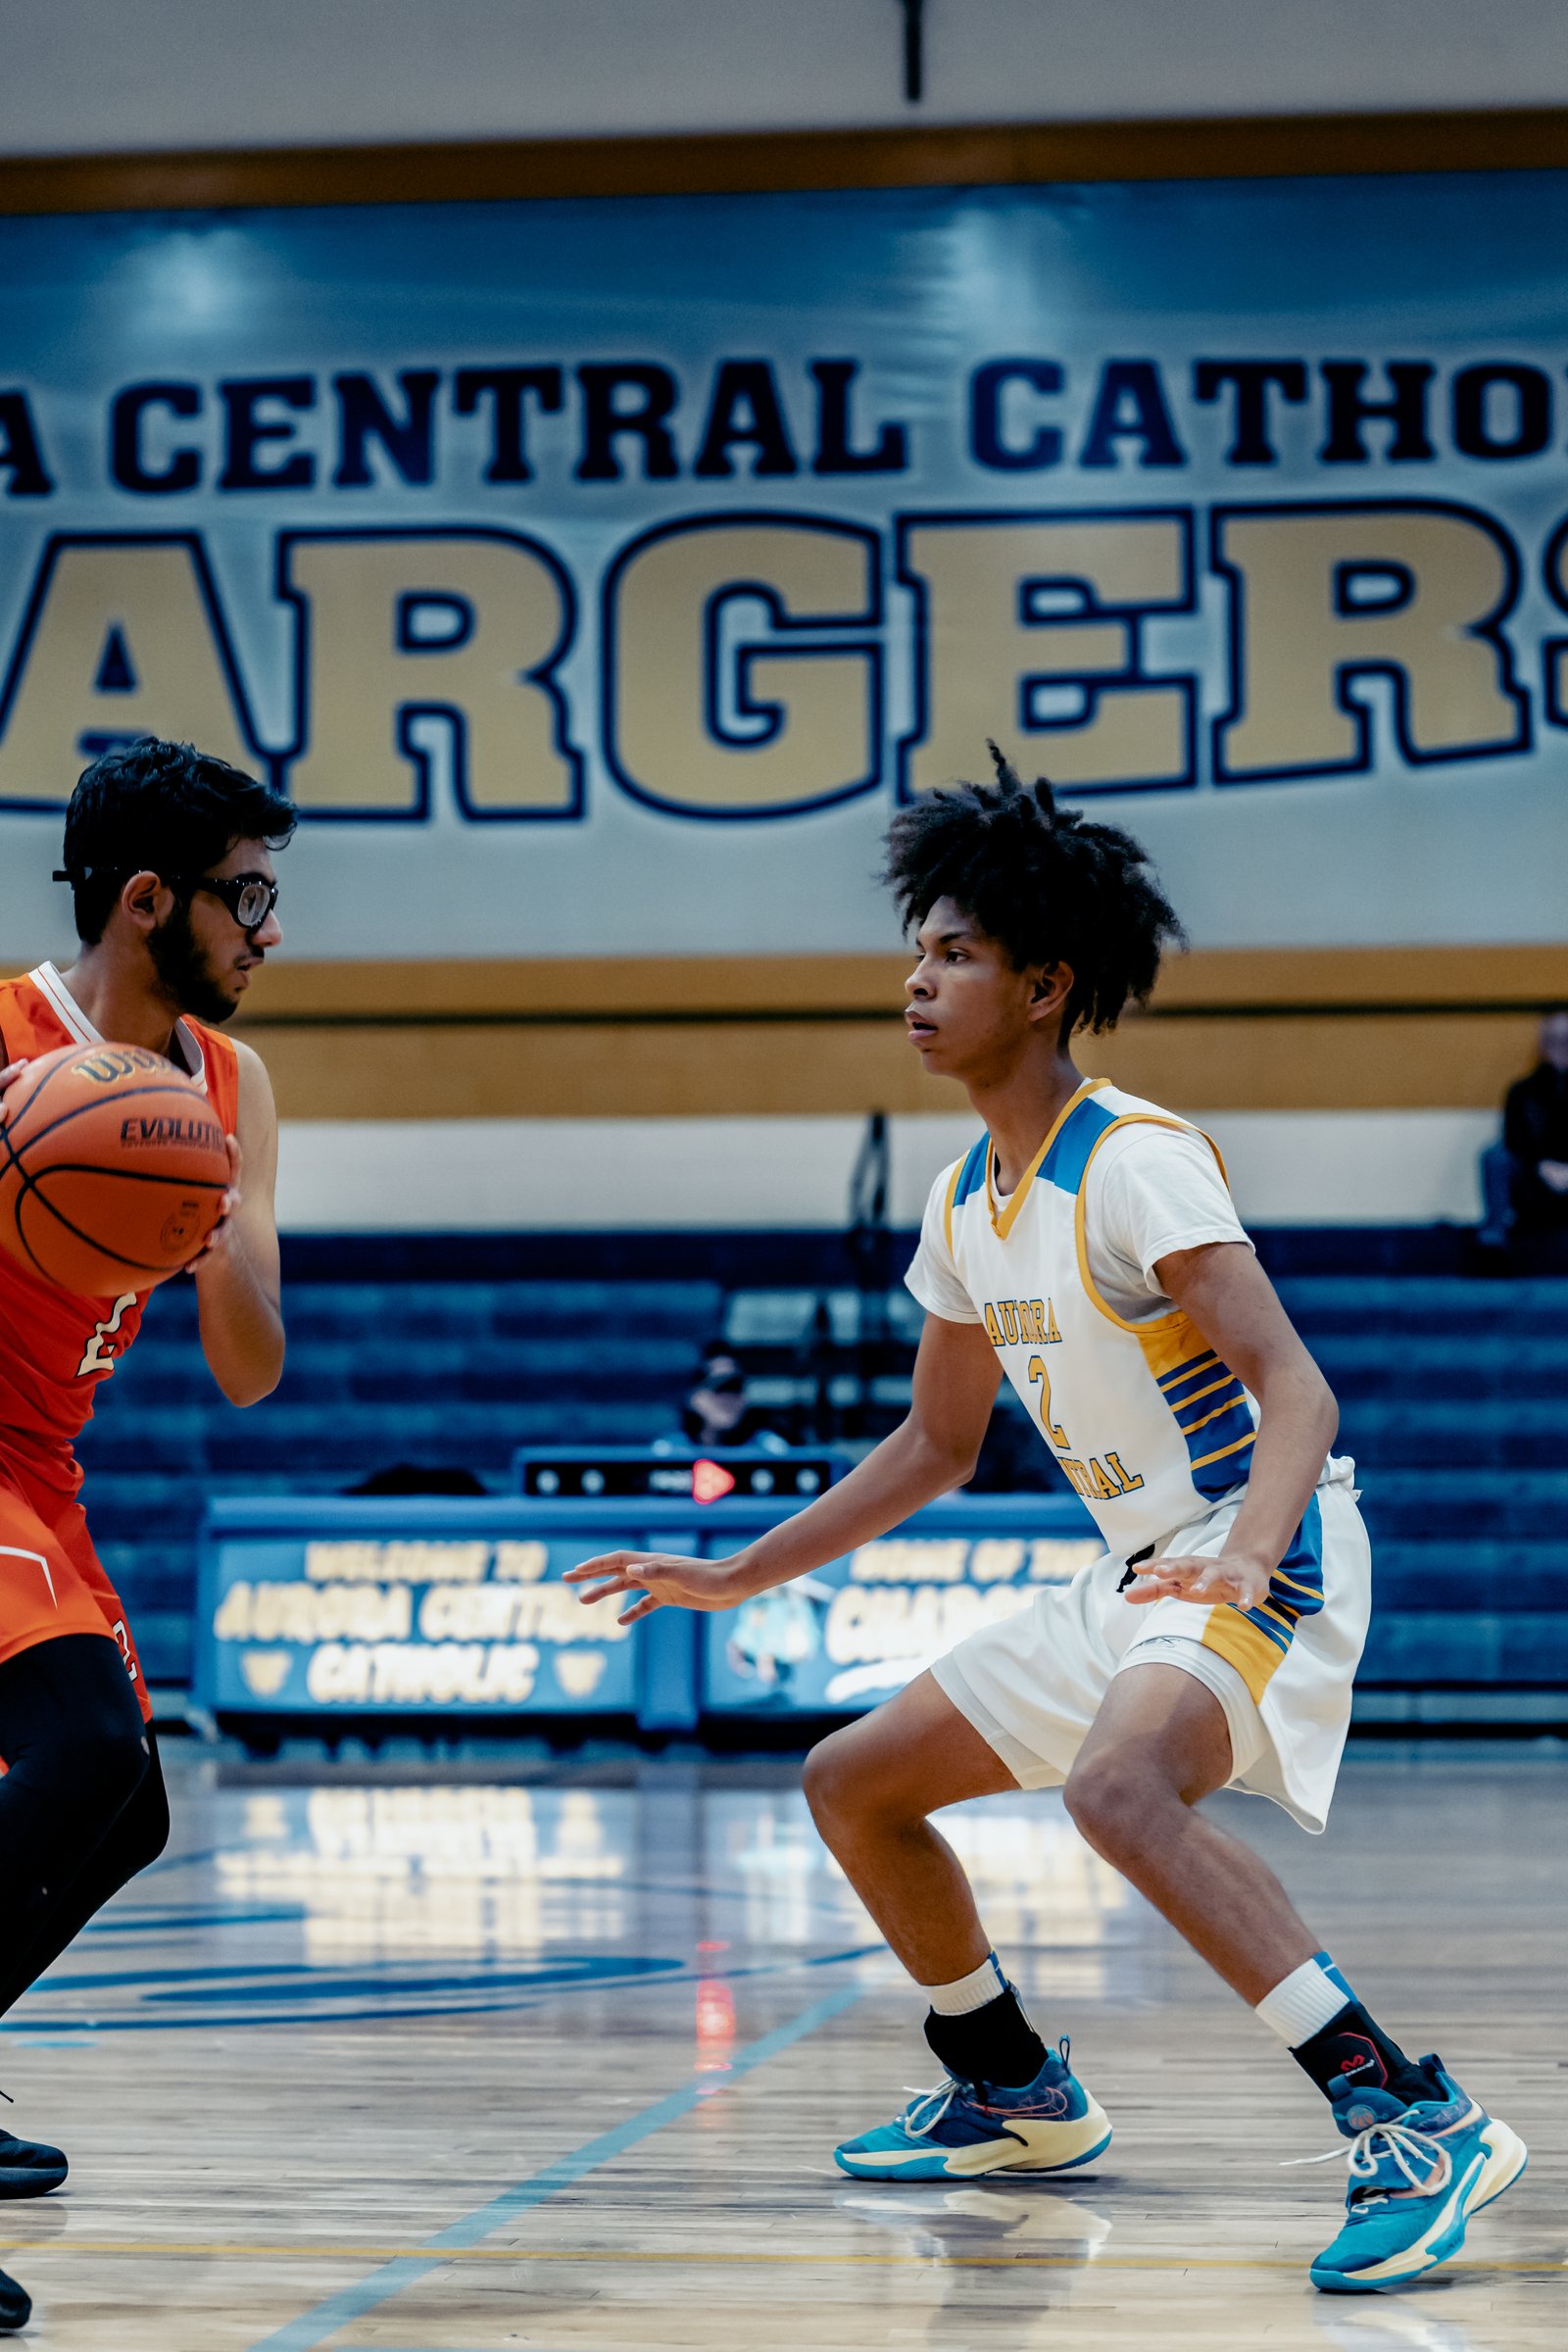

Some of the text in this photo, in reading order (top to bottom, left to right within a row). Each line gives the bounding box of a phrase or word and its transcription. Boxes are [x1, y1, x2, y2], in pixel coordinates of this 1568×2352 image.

[110, 359, 907, 496] CENTRAL
[0, 496, 1568, 821] ARGER
[1028, 1354, 1071, 1450] 2
